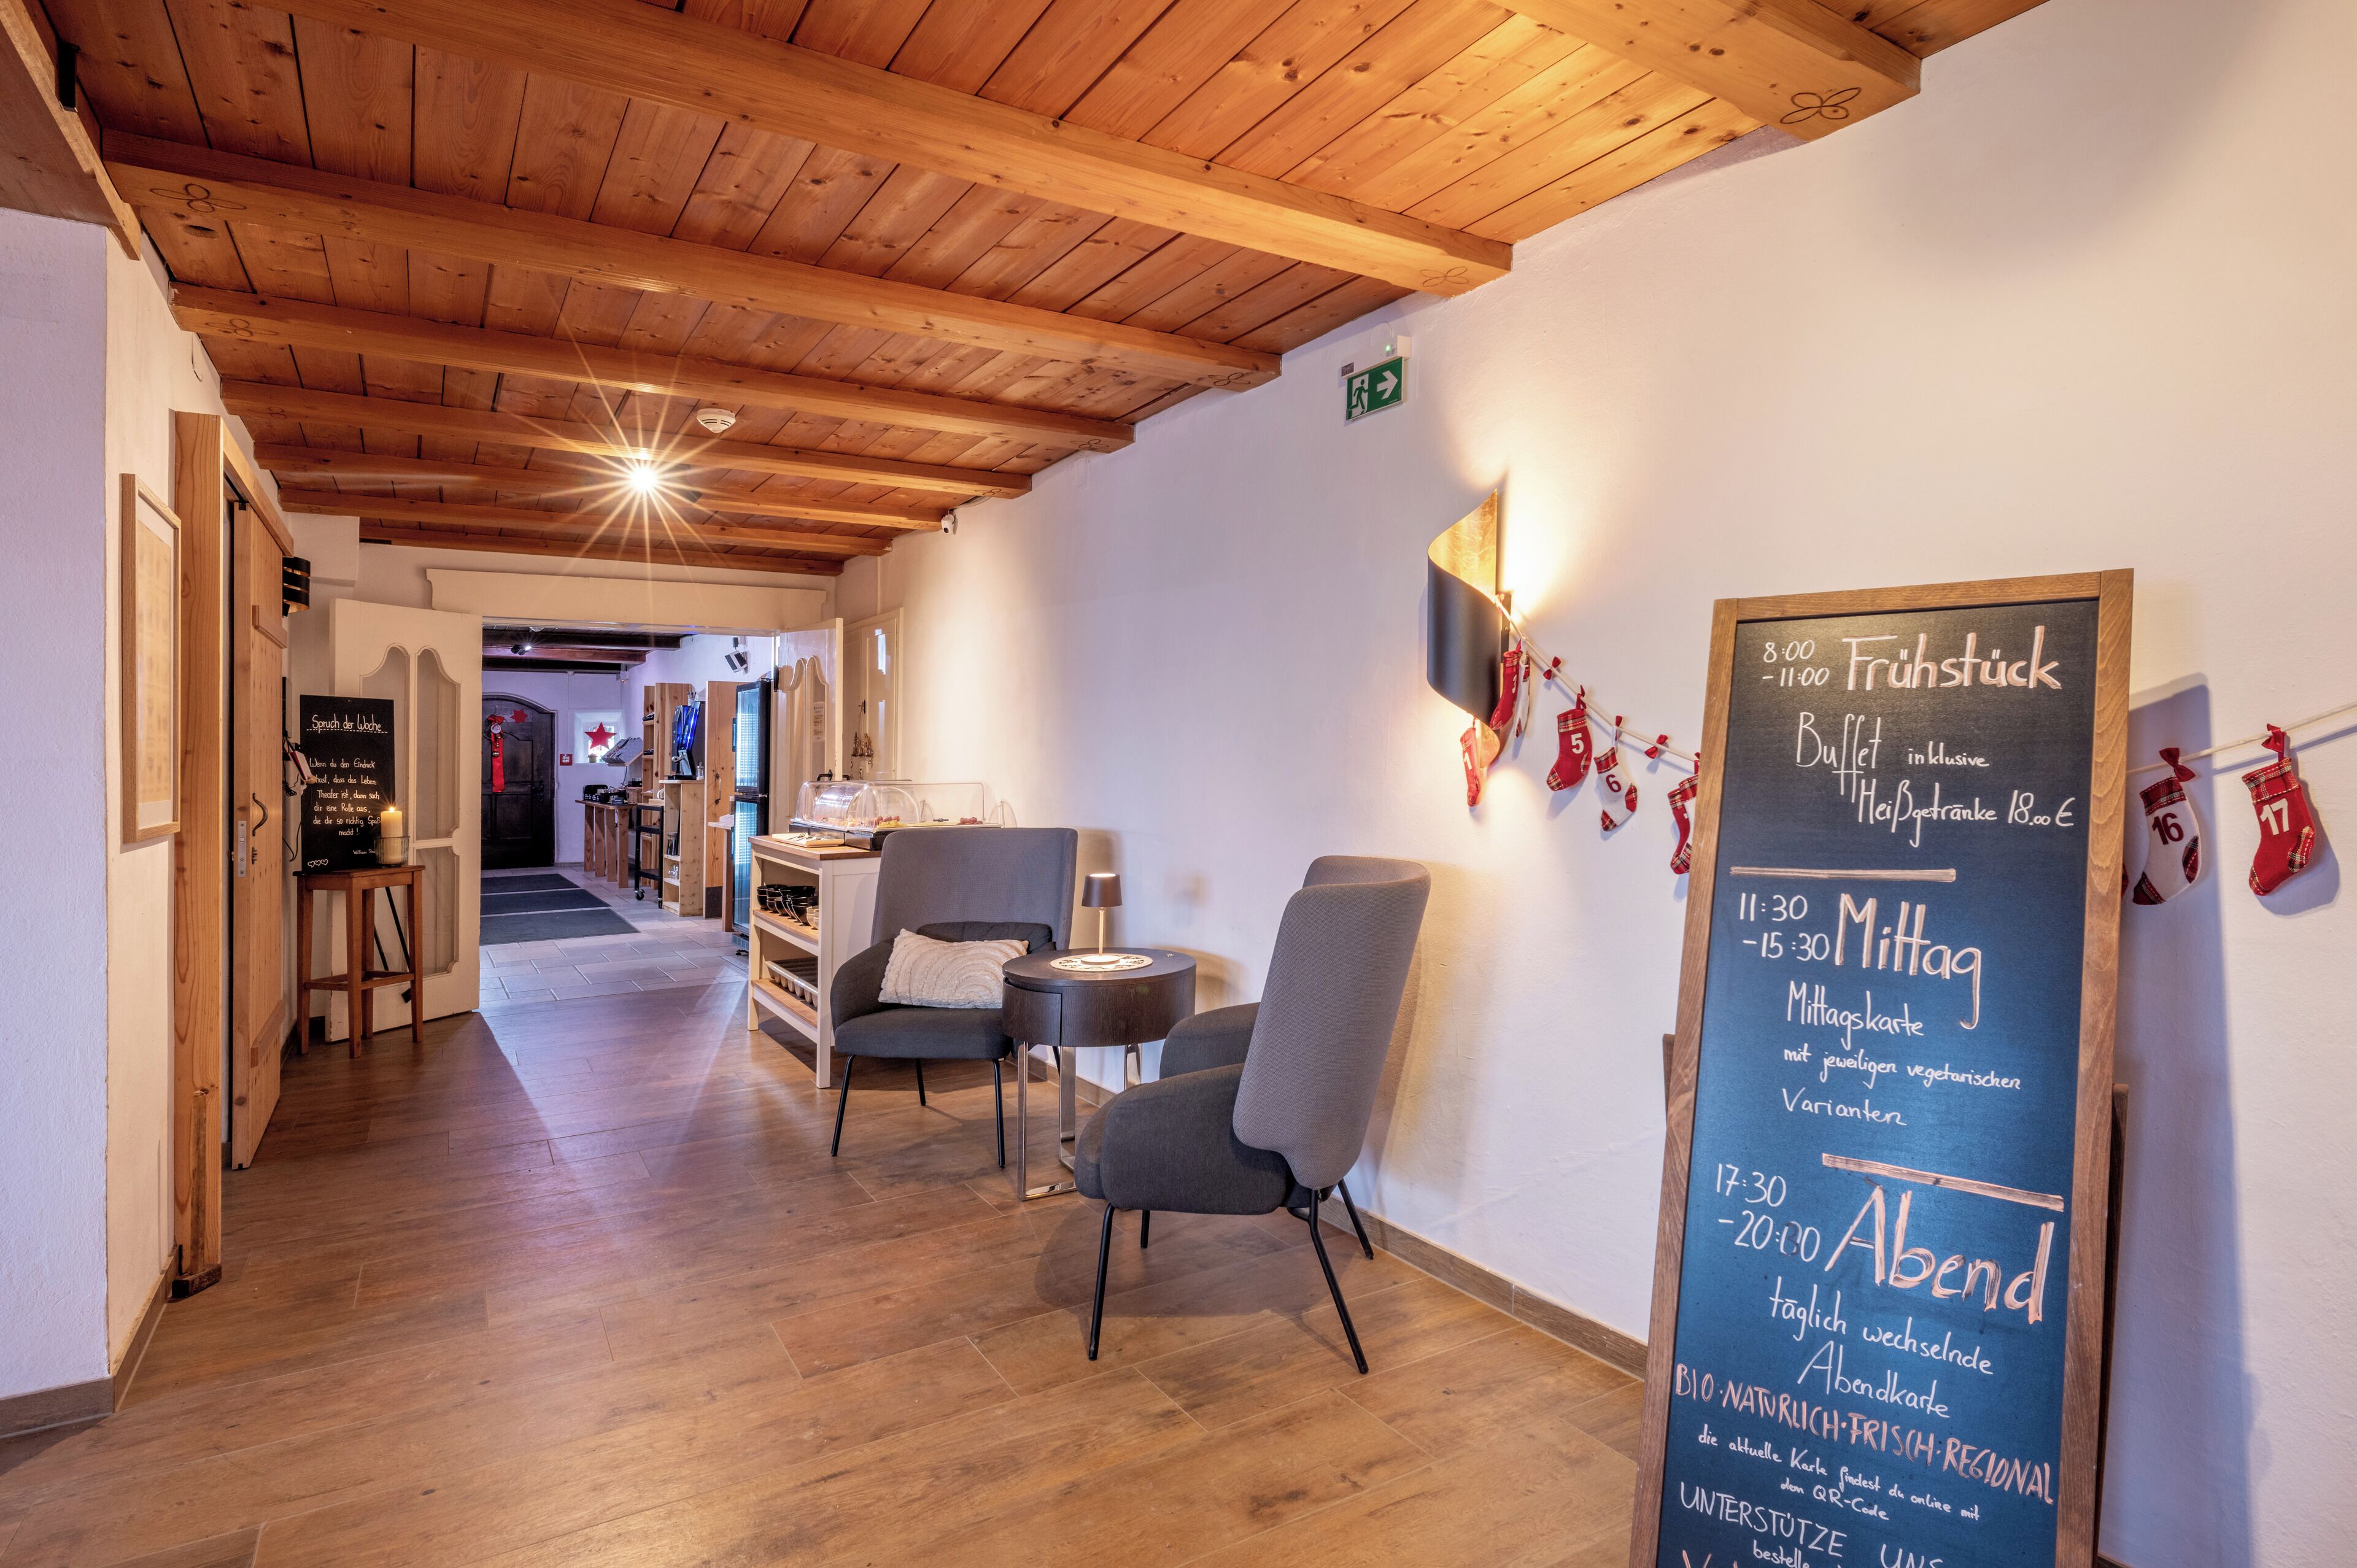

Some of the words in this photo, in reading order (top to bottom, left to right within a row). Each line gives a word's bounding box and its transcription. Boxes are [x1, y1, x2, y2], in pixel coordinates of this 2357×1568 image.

[1763, 639, 1815, 663] 8:00
[1841, 625, 2062, 691] Frühstück
[312, 713, 339, 734] Spruch
[343, 714, 354, 729] der
[357, 713, 382, 732] Woche
[309, 757, 327, 768] Wenn
[330, 759, 337, 768] du
[340, 758, 350, 768] den
[354, 758, 376, 769] Eindruck
[1463, 754, 1473, 771] 1
[1571, 732, 1585, 755] 5
[1795, 711, 1883, 803] Buffet
[1908, 740, 1990, 768] inklusive
[316, 789, 339, 798] Theater
[353, 790, 366, 799] dann
[369, 791, 380, 800] such
[333, 774, 345, 784] dass
[347, 774, 357, 784] das
[361, 774, 377, 785] Leben
[1605, 774, 1622, 793] 6
[314, 801, 322, 812] dir
[341, 802, 354, 813] Rolle
[324, 816, 333, 825] dir
[346, 816, 364, 827] richtig
[1859, 778, 1997, 848] Heißgetränke
[2259, 797, 2289, 836] 17
[2151, 812, 2185, 846] 16
[1740, 892, 1808, 922] 11:30
[1835, 892, 1981, 1030] Mittag
[1787, 979, 1924, 1050] Mittagskarte
[1784, 1043, 1813, 1062] mit
[1819, 1048, 1897, 1089] jeweiligen
[1906, 1062, 2021, 1090] vegetarischen
[1782, 1086, 1906, 1126] Varianten
[1716, 1163, 1787, 1207] 17:30
[1824, 1183, 2054, 1324] Abend
[1769, 1276, 1847, 1341] täglich
[1862, 1316, 1994, 1375] wechselnde
[1797, 1340, 1950, 1418] Abendkarte
[1698, 1423, 1718, 1446] die
[1728, 1436, 1782, 1462] aktuelle
[1790, 1447, 1827, 1475] Karte
[1839, 1466, 1881, 1493] findest
[1889, 1483, 1904, 1499] du
[1910, 1494, 1951, 1513] online
[1960, 1505, 1980, 1521] mit
[1679, 1481, 1847, 1557] UNTERSTÜTZE
[1813, 1485, 1889, 1521] QR-Code
